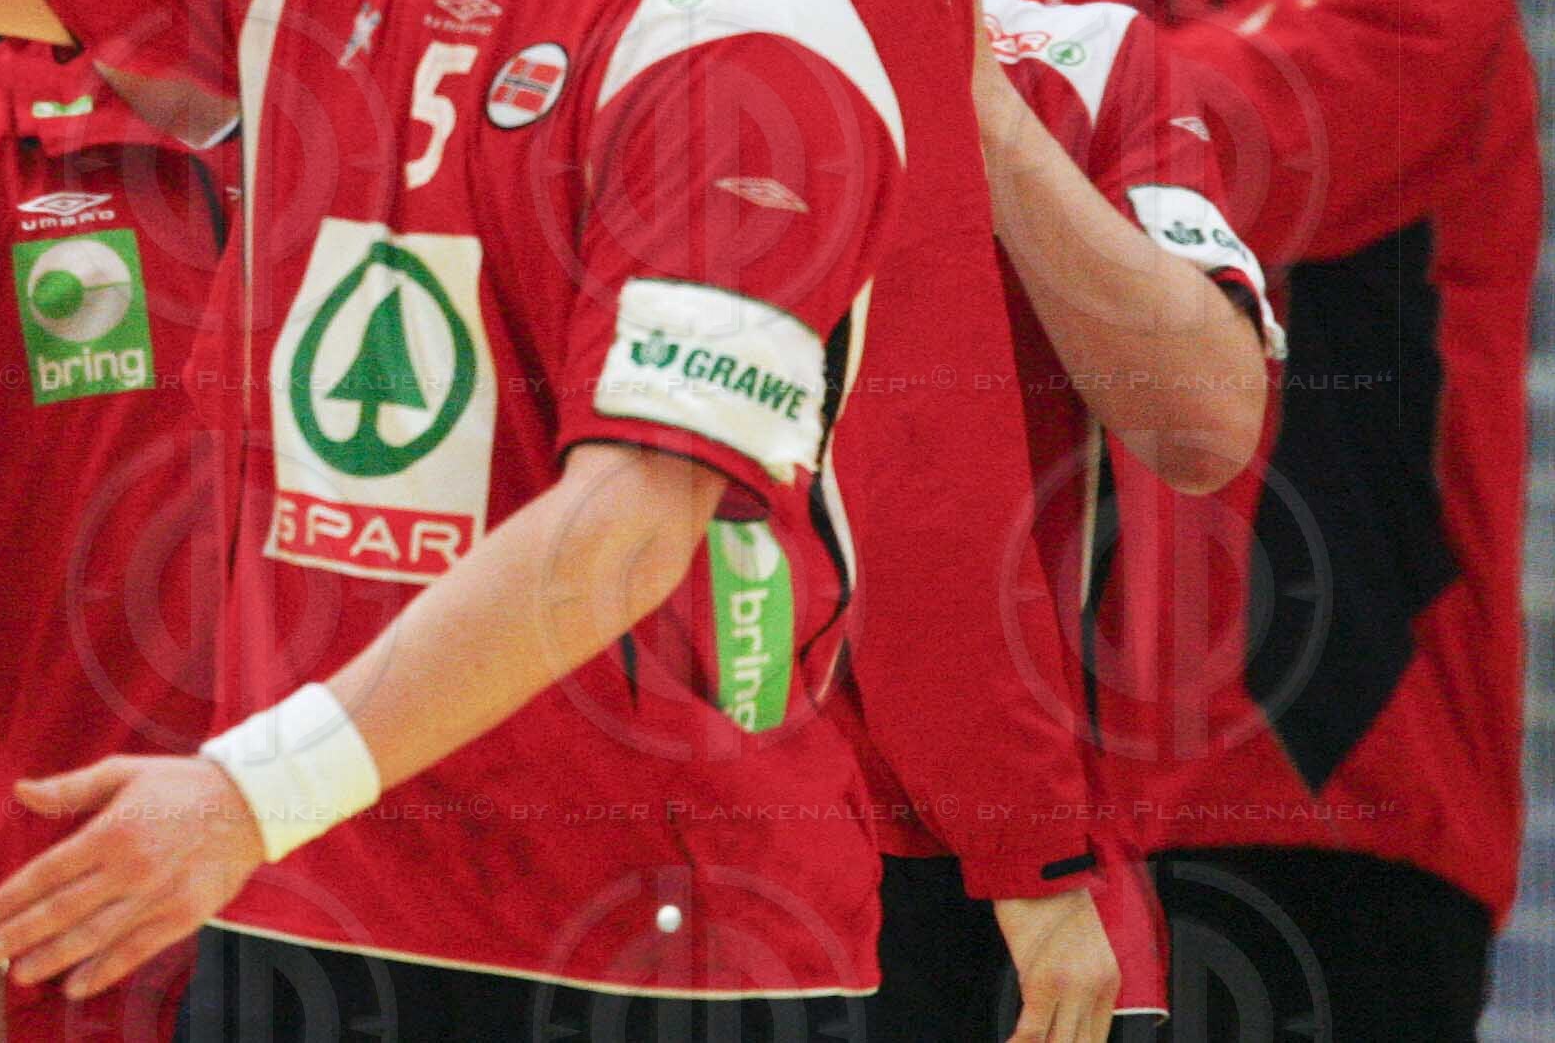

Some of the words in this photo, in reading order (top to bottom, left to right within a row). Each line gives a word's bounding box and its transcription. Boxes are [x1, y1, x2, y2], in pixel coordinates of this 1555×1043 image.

[404, 41, 479, 190] 5
[37, 346, 147, 392] bring
[682, 348, 808, 422] GRAWE
